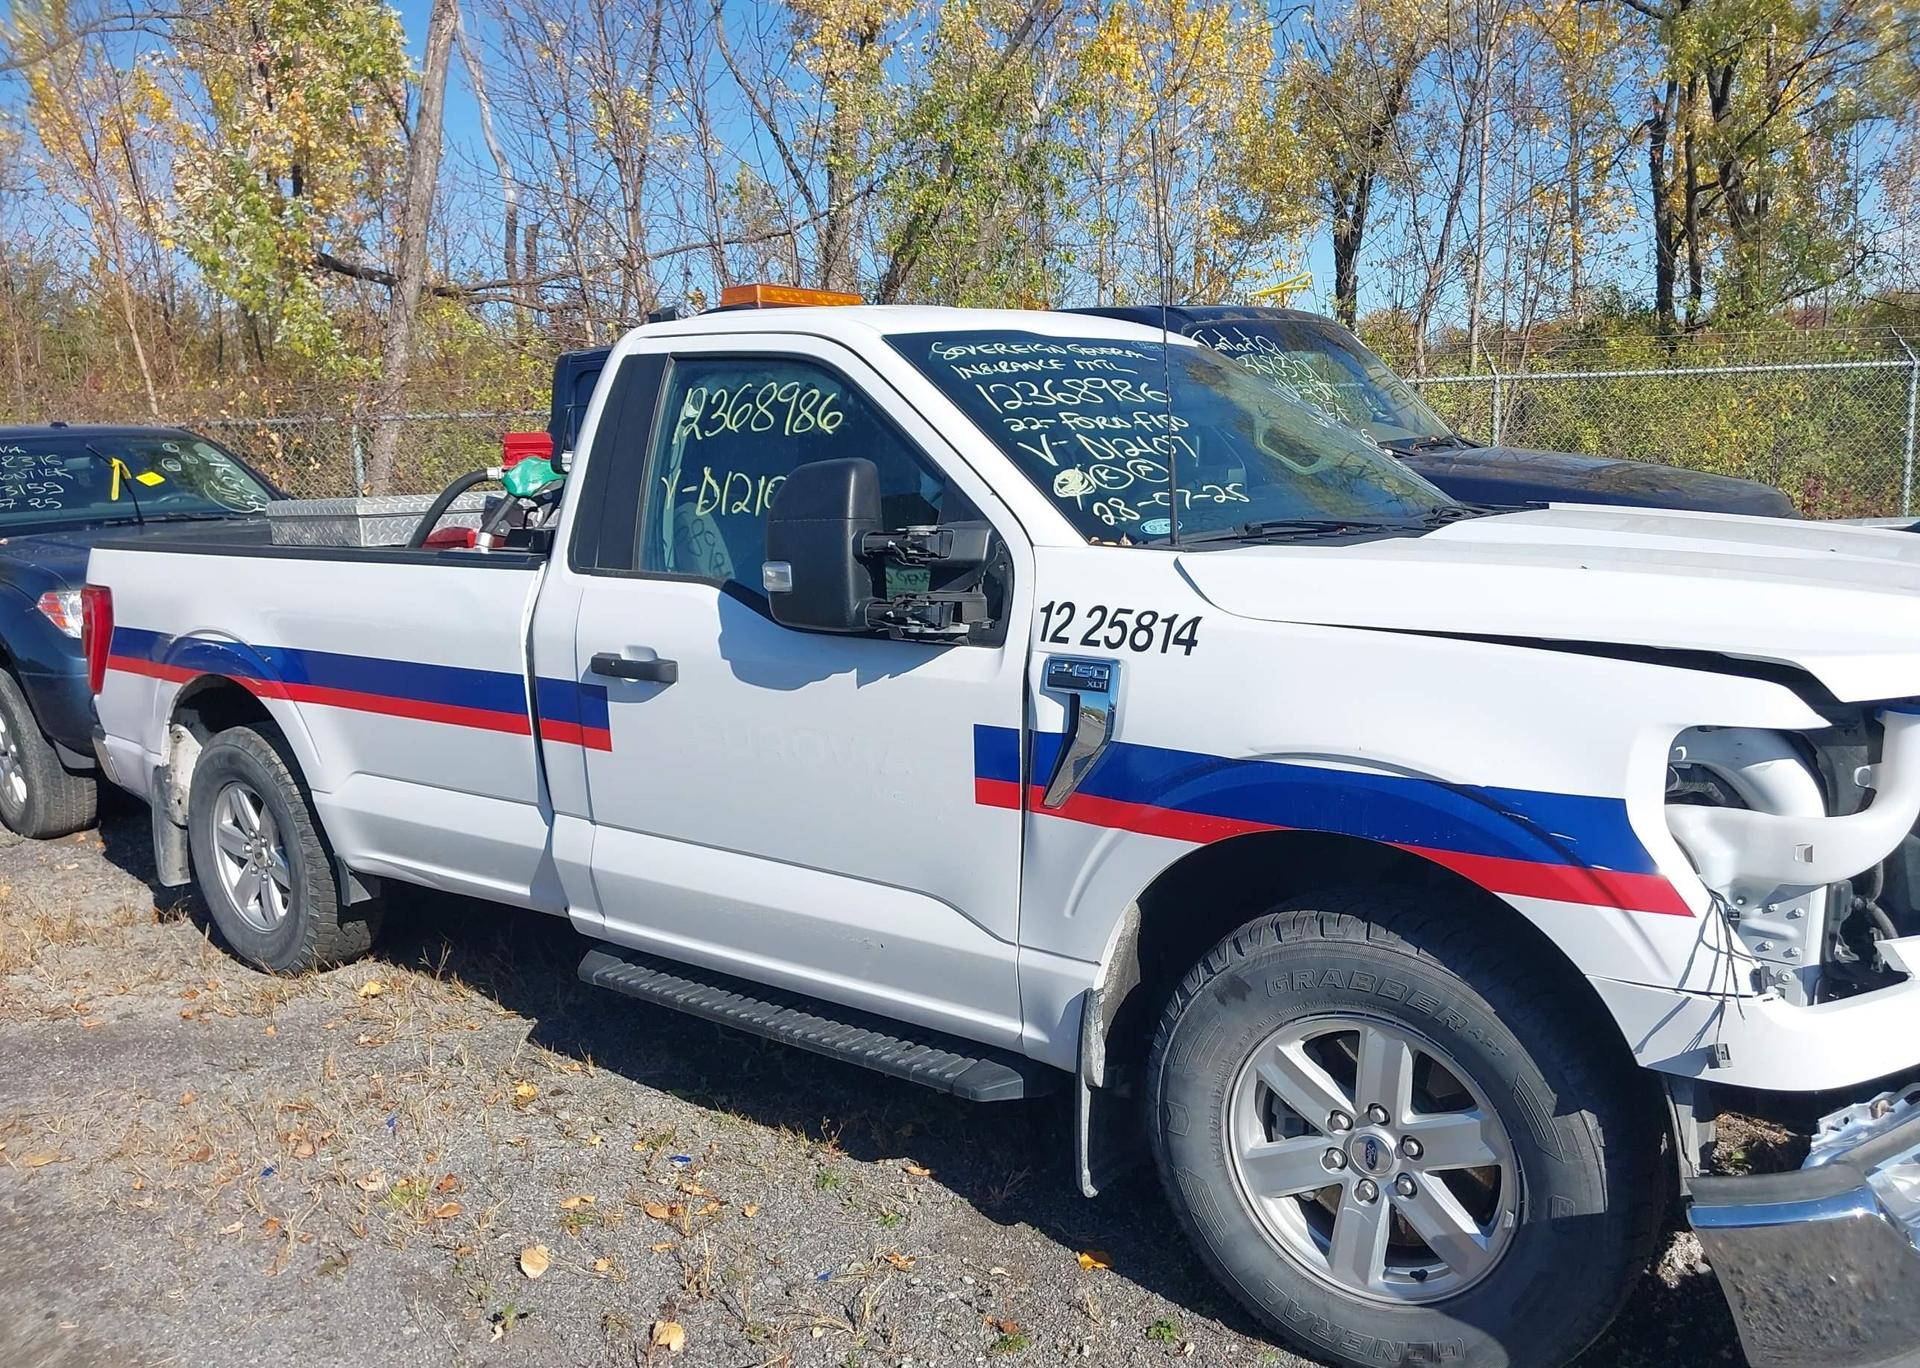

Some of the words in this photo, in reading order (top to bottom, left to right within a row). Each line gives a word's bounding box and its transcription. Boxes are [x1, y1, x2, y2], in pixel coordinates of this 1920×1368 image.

[975, 378, 1172, 413] 12368986
[1039, 600, 1076, 644] 12
[1080, 605, 1203, 656] 25814
[1087, 680, 1105, 689] XLT
[1266, 968, 1470, 1032] GRABBER
[1264, 1278, 1466, 1364] GENERAL
